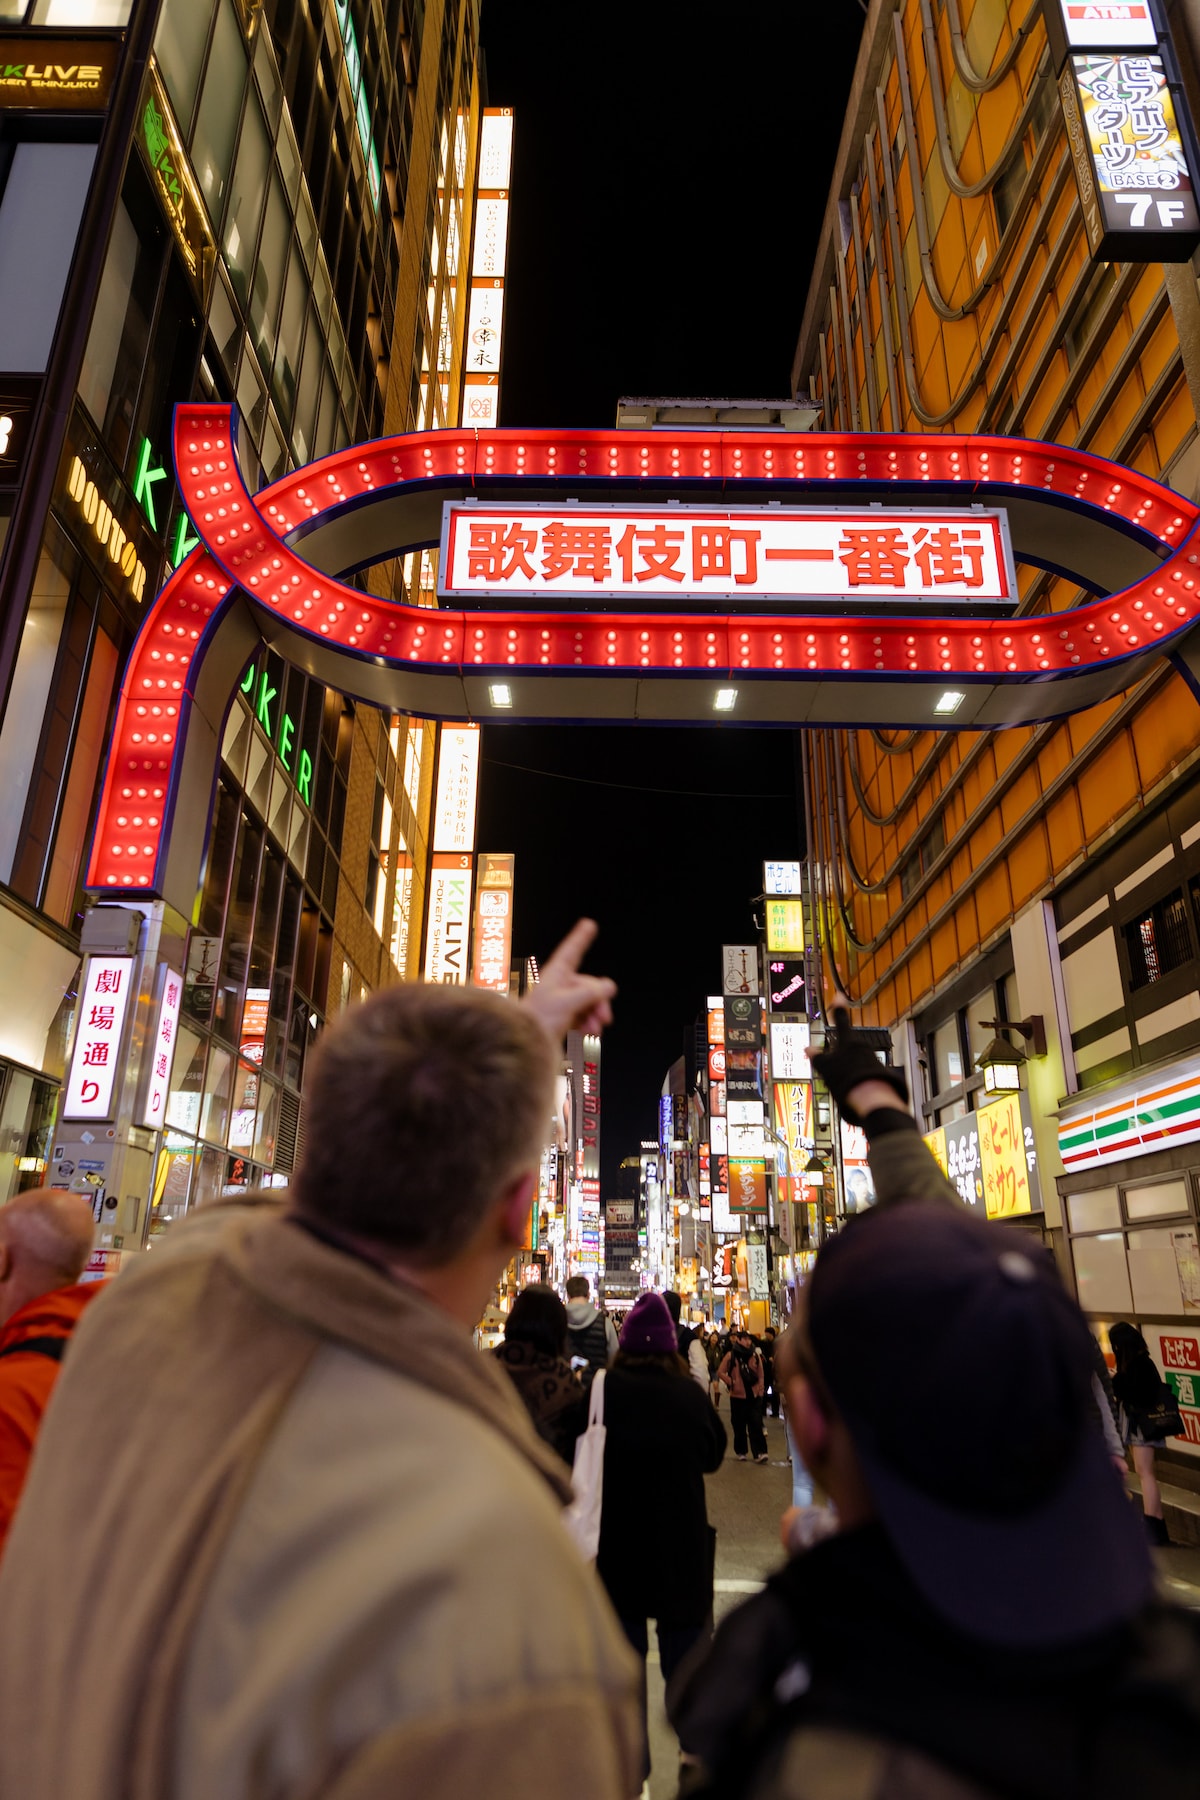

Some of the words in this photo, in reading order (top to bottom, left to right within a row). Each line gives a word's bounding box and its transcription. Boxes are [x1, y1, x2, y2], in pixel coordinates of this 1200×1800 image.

[1083, 6, 1132, 19] ATM
[0, 64, 103, 80] KLIVE
[31, 80, 99, 89] SHINJUKU
[500, 108, 511, 116] 10
[499, 190, 506, 199] 9
[1114, 194, 1185, 228] 7F
[493, 279, 501, 288] 8
[487, 375, 495, 385] 7
[67, 455, 147, 604] DOUTOR
[467, 522, 987, 588] 歌舞伎町一番街
[460, 855, 469, 868] 3
[435, 879, 445, 923] POKER
[443, 880, 465, 986] KKLIVE
[480, 917, 505, 984] 安楽亭
[770, 962, 785, 973] 4F
[80, 969, 122, 1104] 劇場通り
[152, 982, 179, 1112] 劇場通り
[1164, 1339, 1197, 1367] たばこ
[1175, 1374, 1195, 1405] 酒
